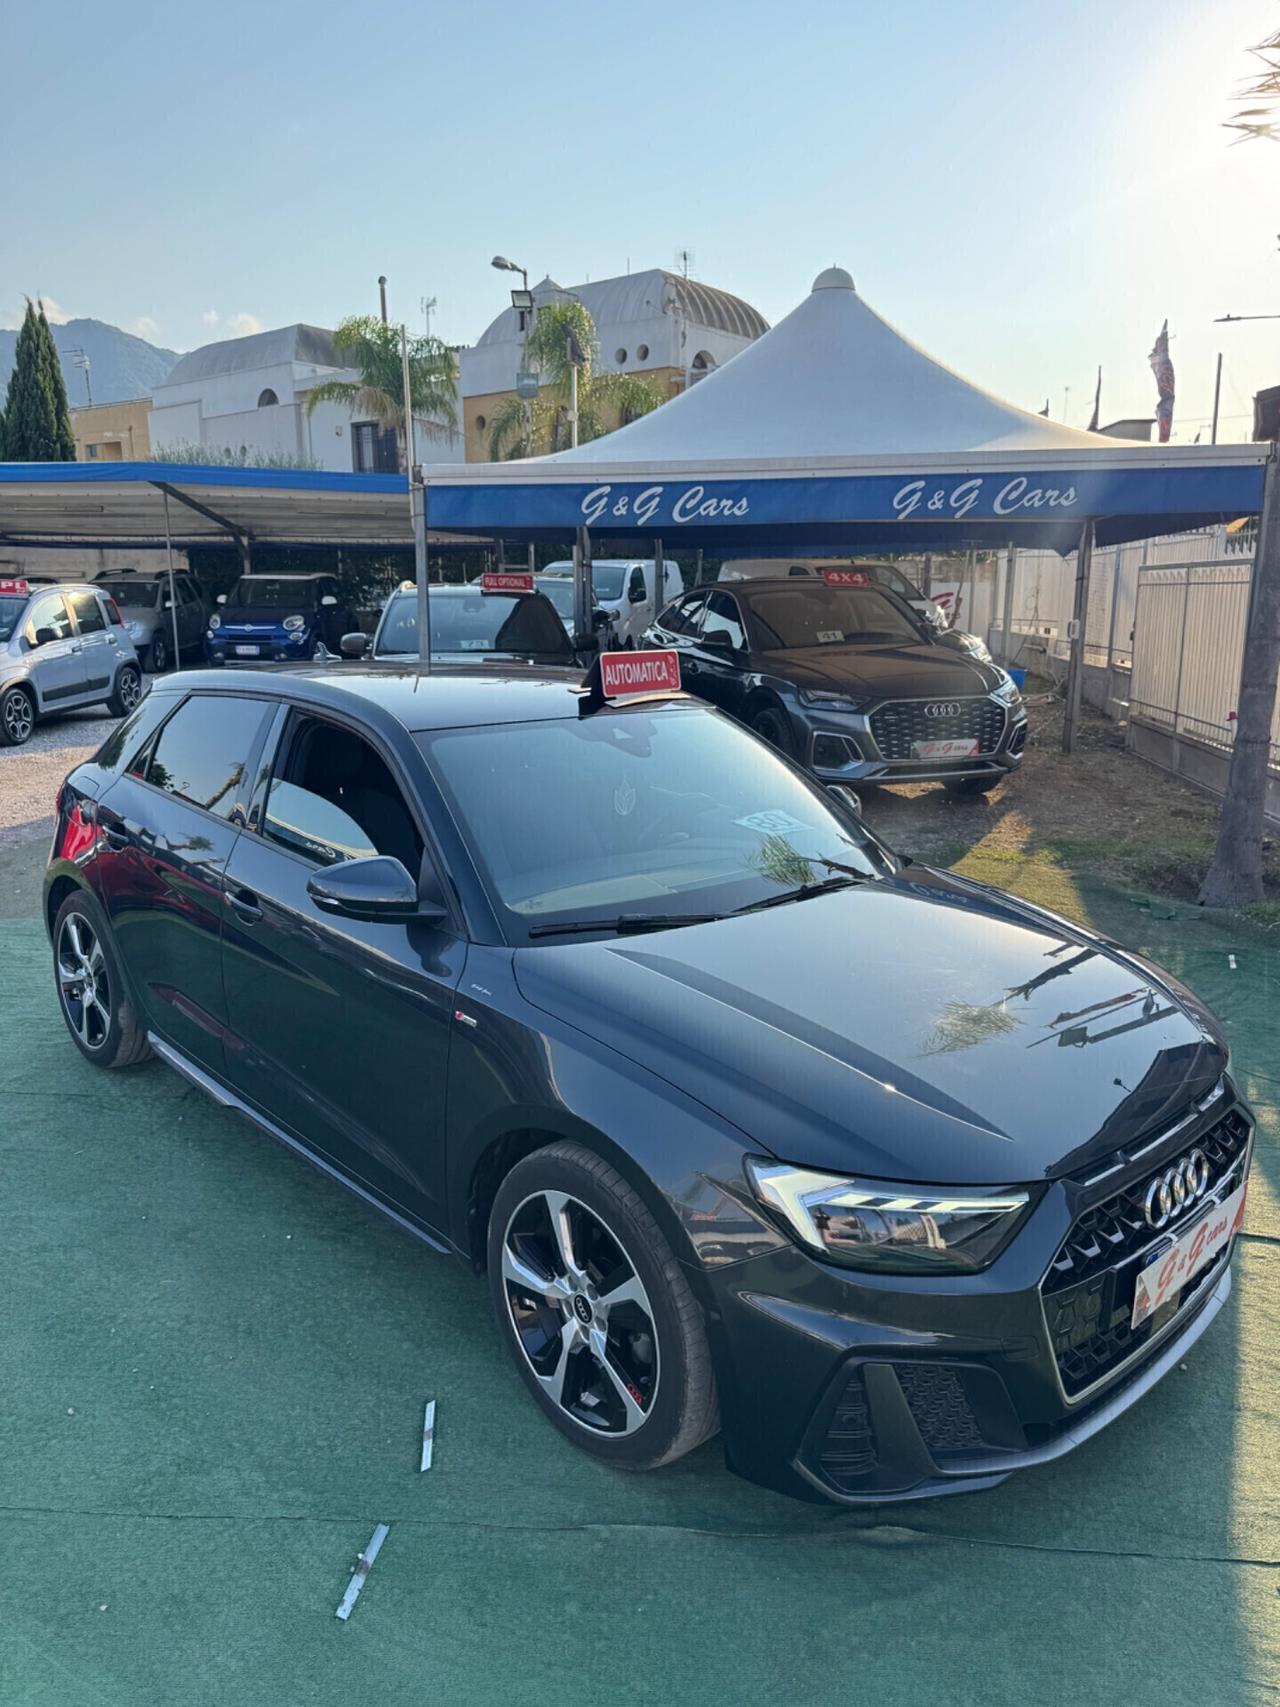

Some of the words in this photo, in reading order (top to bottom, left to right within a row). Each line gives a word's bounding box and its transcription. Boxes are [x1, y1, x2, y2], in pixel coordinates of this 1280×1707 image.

[672, 485, 750, 523] Cars
[993, 476, 1078, 515] Cars
[605, 660, 669, 686] AUTOMATICA
